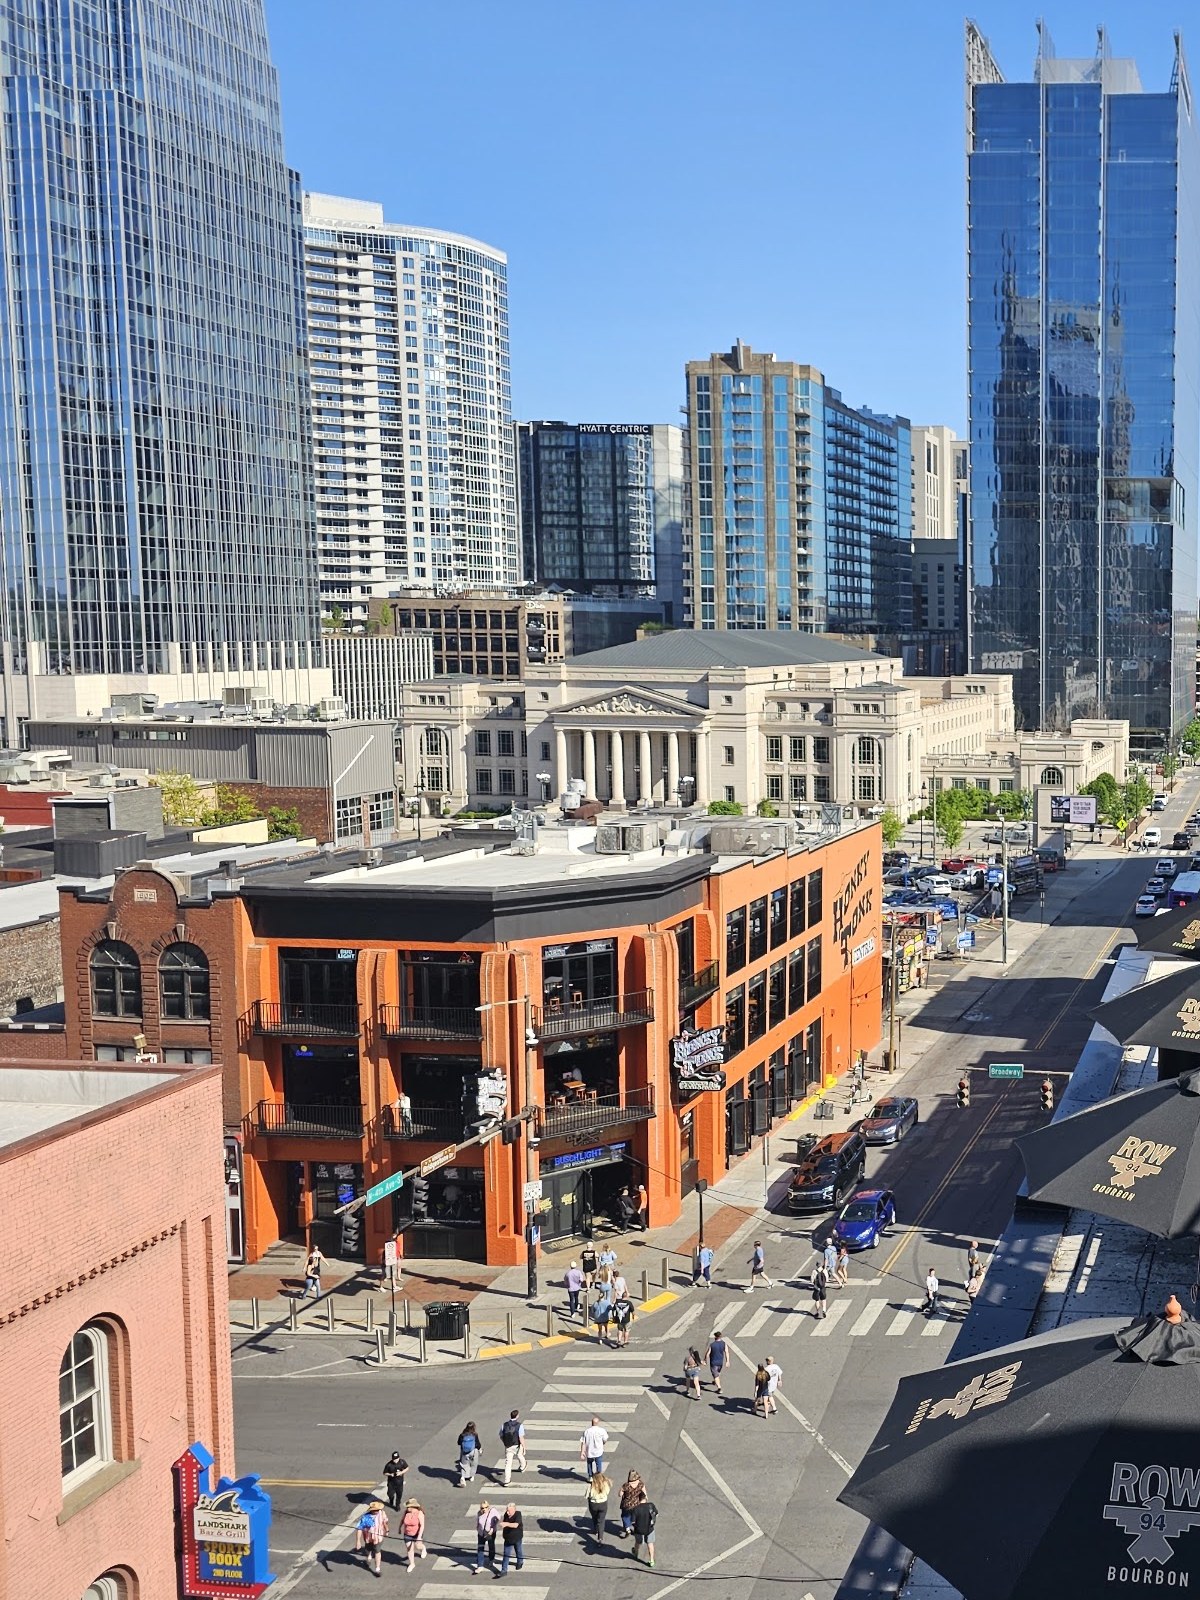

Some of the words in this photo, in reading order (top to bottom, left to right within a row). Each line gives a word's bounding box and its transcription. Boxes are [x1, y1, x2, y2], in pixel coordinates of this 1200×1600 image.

[580, 425, 607, 433] HYATT
[610, 425, 648, 433] CENTRIC
[833, 850, 870, 944] HONKY
[840, 888, 873, 970] TONK
[854, 938, 874, 962] CENTRAL
[674, 1029, 720, 1062] HONKY
[683, 1046, 724, 1073] TONK
[991, 1068, 1020, 1076] Broadway
[679, 1081, 720, 1090] CENTRAL
[555, 1154, 579, 1166] BUSCH
[580, 1149, 603, 1160] LIGHT
[1116, 1136, 1177, 1166] ROW
[1125, 1163, 1140, 1173] 94
[1093, 1184, 1136, 1201] BOURBON
[972, 1360, 1023, 1410] ROW
[198, 1520, 247, 1530] LANDSHARK
[1140, 1514, 1166, 1531] 94
[226, 1529, 246, 1538] Grill
[204, 1542, 250, 1555] SPORTS
[209, 1552, 242, 1566] BOOK
[213, 1569, 224, 1577] 2ND
[225, 1569, 243, 1579] FLOOR
[1107, 1566, 1189, 1587] BOURBON
